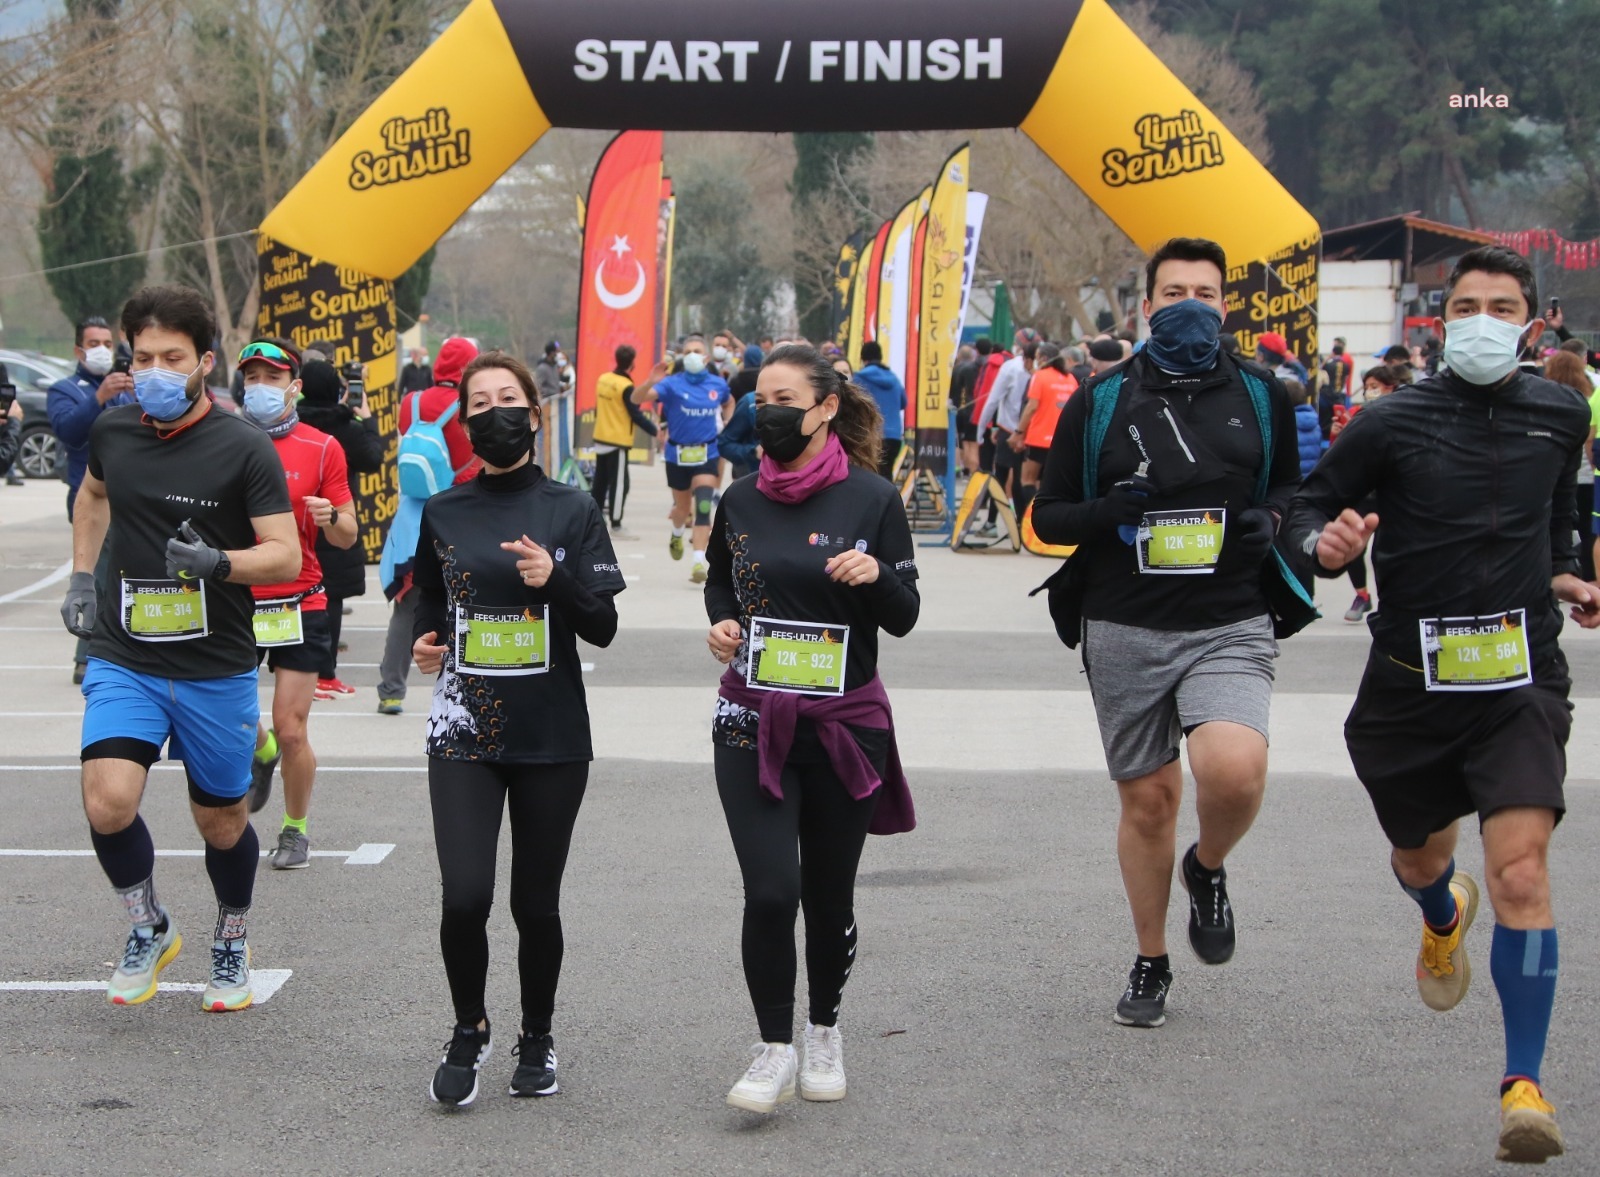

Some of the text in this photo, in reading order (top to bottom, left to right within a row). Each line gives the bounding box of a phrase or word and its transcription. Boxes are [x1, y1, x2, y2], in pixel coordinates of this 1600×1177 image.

[573, 38, 1003, 83] START / FINISH
[380, 107, 450, 153] Limit
[1134, 110, 1203, 152] Limit
[349, 129, 471, 190] Sensin!
[1102, 132, 1225, 187] Sensin!
[272, 252, 299, 273] Limit
[1276, 255, 1316, 290] Limit
[264, 261, 309, 291] Sensin!
[165, 494, 195, 504] JIMMY
[1164, 536, 1184, 549] 12K
[1196, 534, 1215, 548] 514
[144, 603, 163, 617] 12K
[174, 602, 192, 616] 314
[481, 632, 501, 647] 12K
[514, 631, 535, 647] 921
[1456, 646, 1481, 662] 12K
[1496, 641, 1518, 660] 564
[776, 650, 797, 666] 12K
[810, 653, 834, 669] 922
